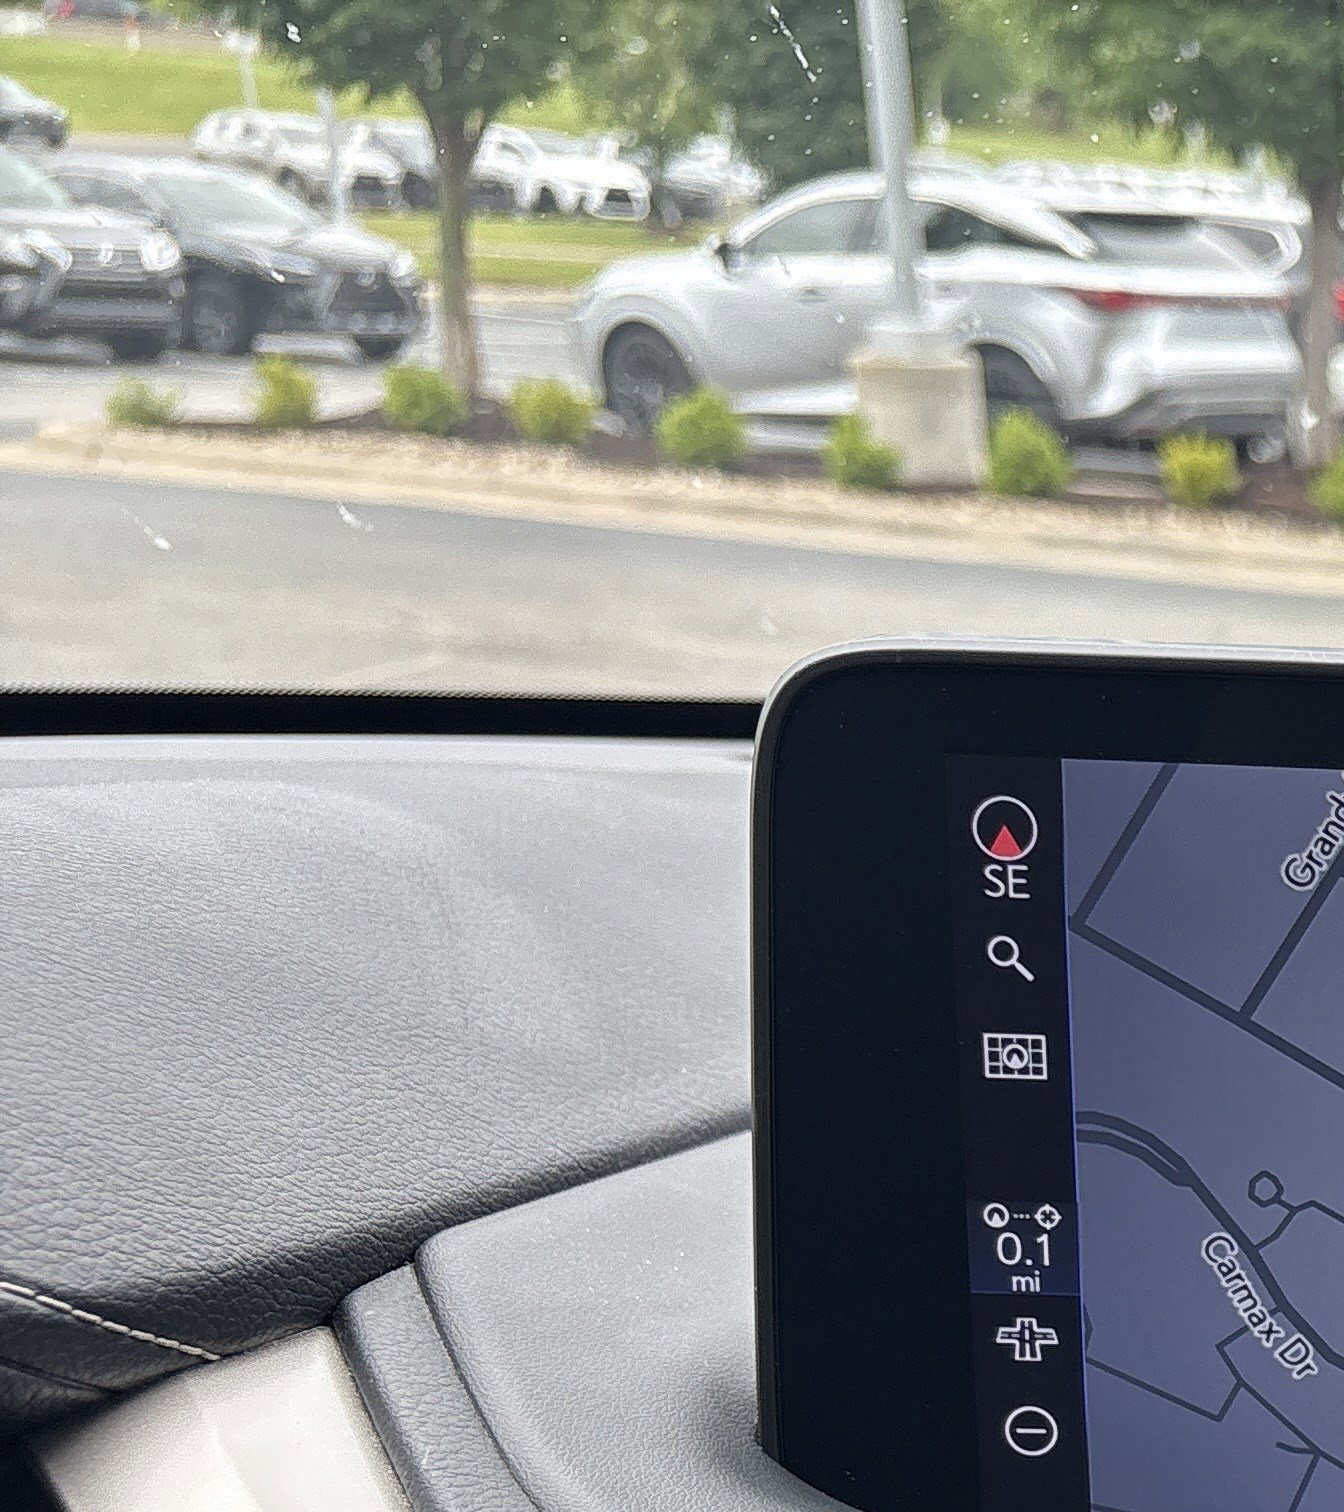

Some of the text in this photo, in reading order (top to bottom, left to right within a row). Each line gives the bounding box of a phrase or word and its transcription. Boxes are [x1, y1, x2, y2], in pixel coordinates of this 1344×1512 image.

[982, 863, 1031, 900] SE
[995, 1231, 1052, 1267] 0.1
[1010, 1269, 1042, 1293] mi
[1202, 1233, 1318, 1378] Carmax Dr
